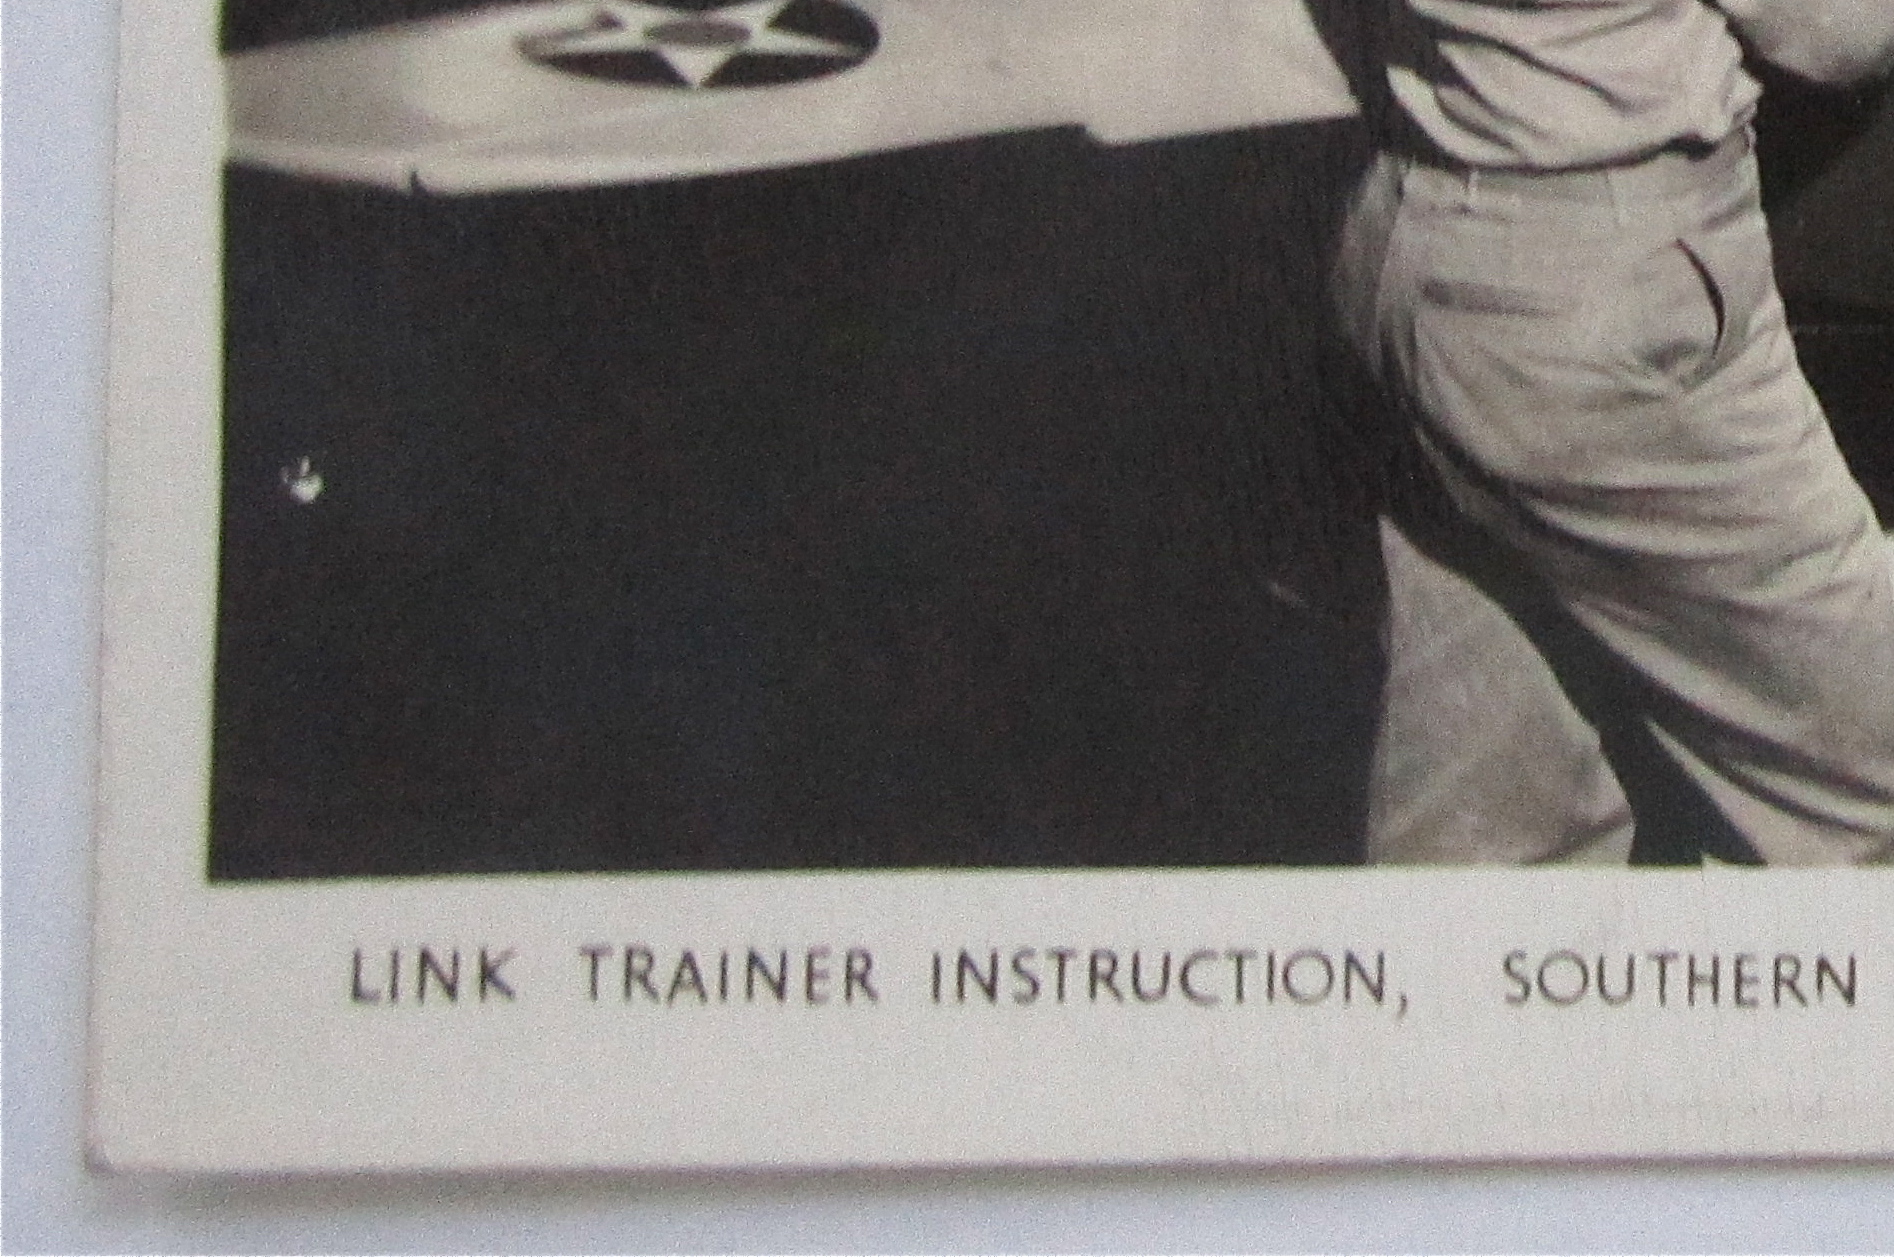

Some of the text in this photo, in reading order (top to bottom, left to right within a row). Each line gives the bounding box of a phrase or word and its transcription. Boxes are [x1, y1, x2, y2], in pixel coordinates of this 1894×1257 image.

[348, 945, 517, 1007] LINK
[578, 944, 880, 1007] TRAINER
[930, 947, 1411, 1020] INSTRUCTION,
[1501, 949, 1858, 1010] SOUTHERN
